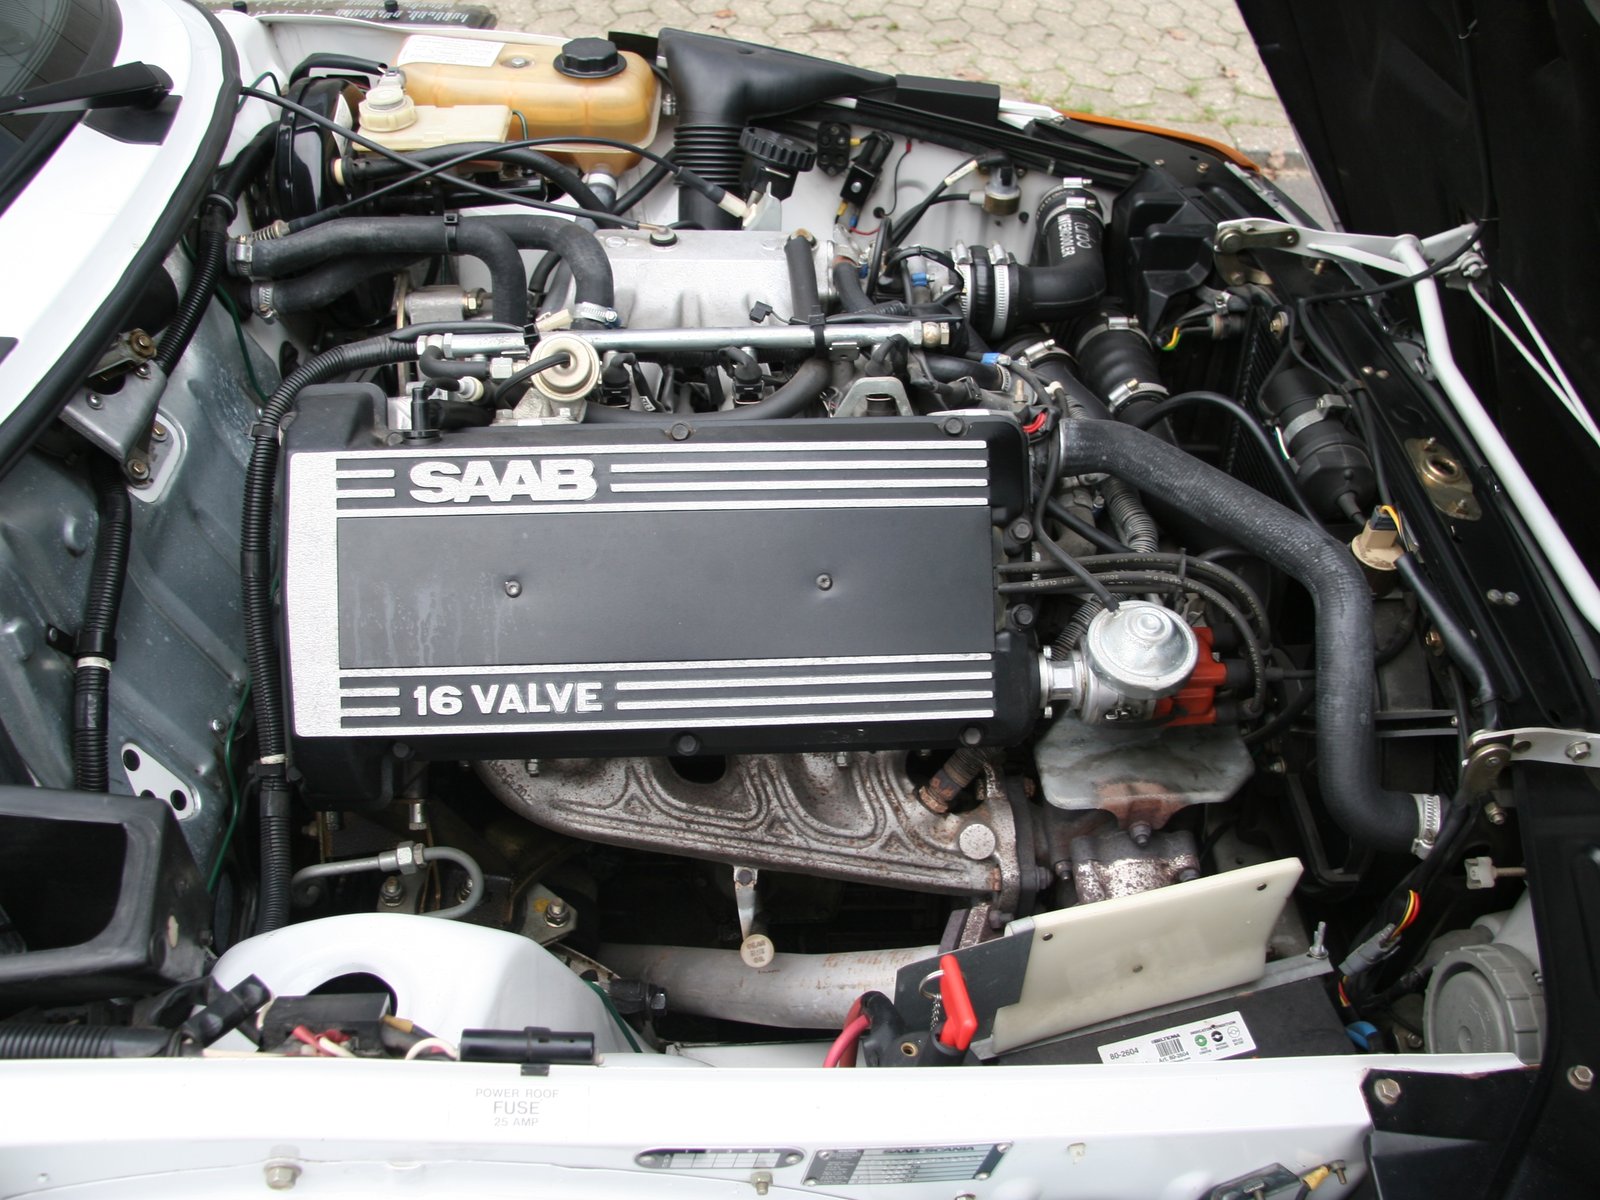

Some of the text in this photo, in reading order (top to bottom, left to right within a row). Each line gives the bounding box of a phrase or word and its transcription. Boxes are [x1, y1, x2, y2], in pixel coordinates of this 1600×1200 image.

[1057, 213, 1076, 258] INTERCOOLER
[409, 458, 598, 503] SAAB
[413, 682, 603, 715] 16 VALVE
[1109, 1047, 1140, 1060] 80-2604
[475, 1087, 560, 1099] POWER ROOF
[493, 1100, 541, 1115] FUSE
[493, 1116, 539, 1127] 25 AMP
